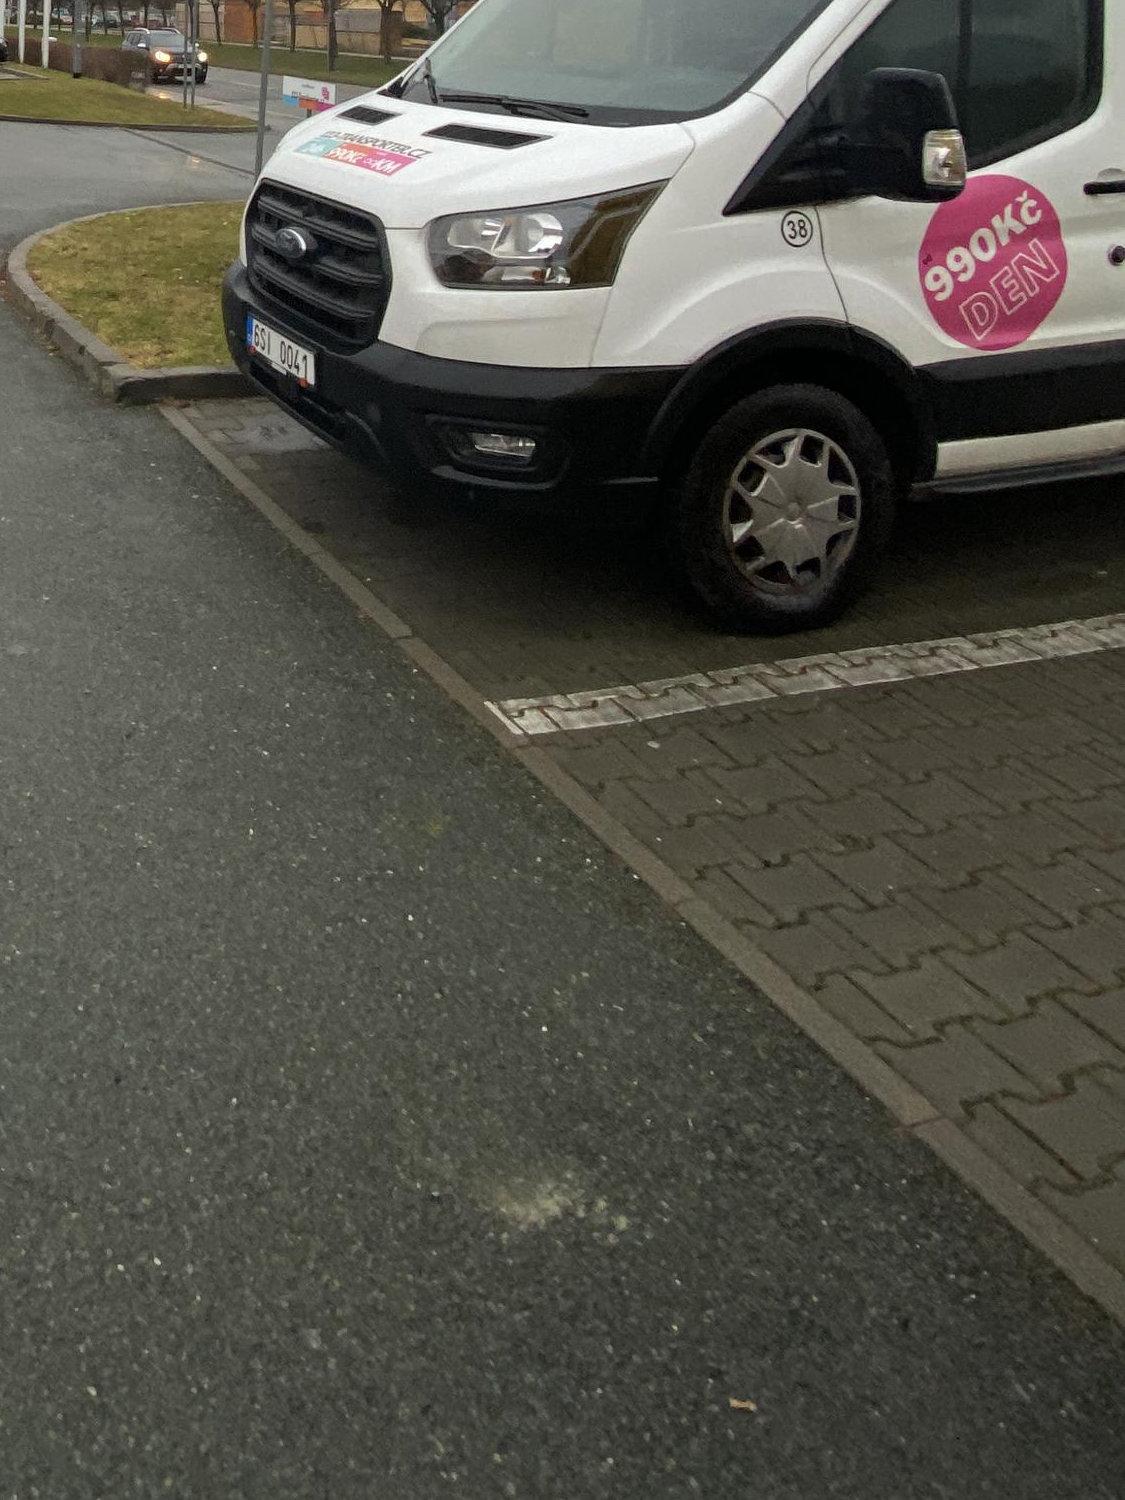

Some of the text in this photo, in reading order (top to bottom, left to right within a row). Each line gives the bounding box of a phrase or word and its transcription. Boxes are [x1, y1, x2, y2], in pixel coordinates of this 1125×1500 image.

[786, 218, 808, 240] 38
[925, 190, 1042, 301] 990Kč
[959, 238, 1060, 341] DEN
[280, 340, 308, 380] 0041
